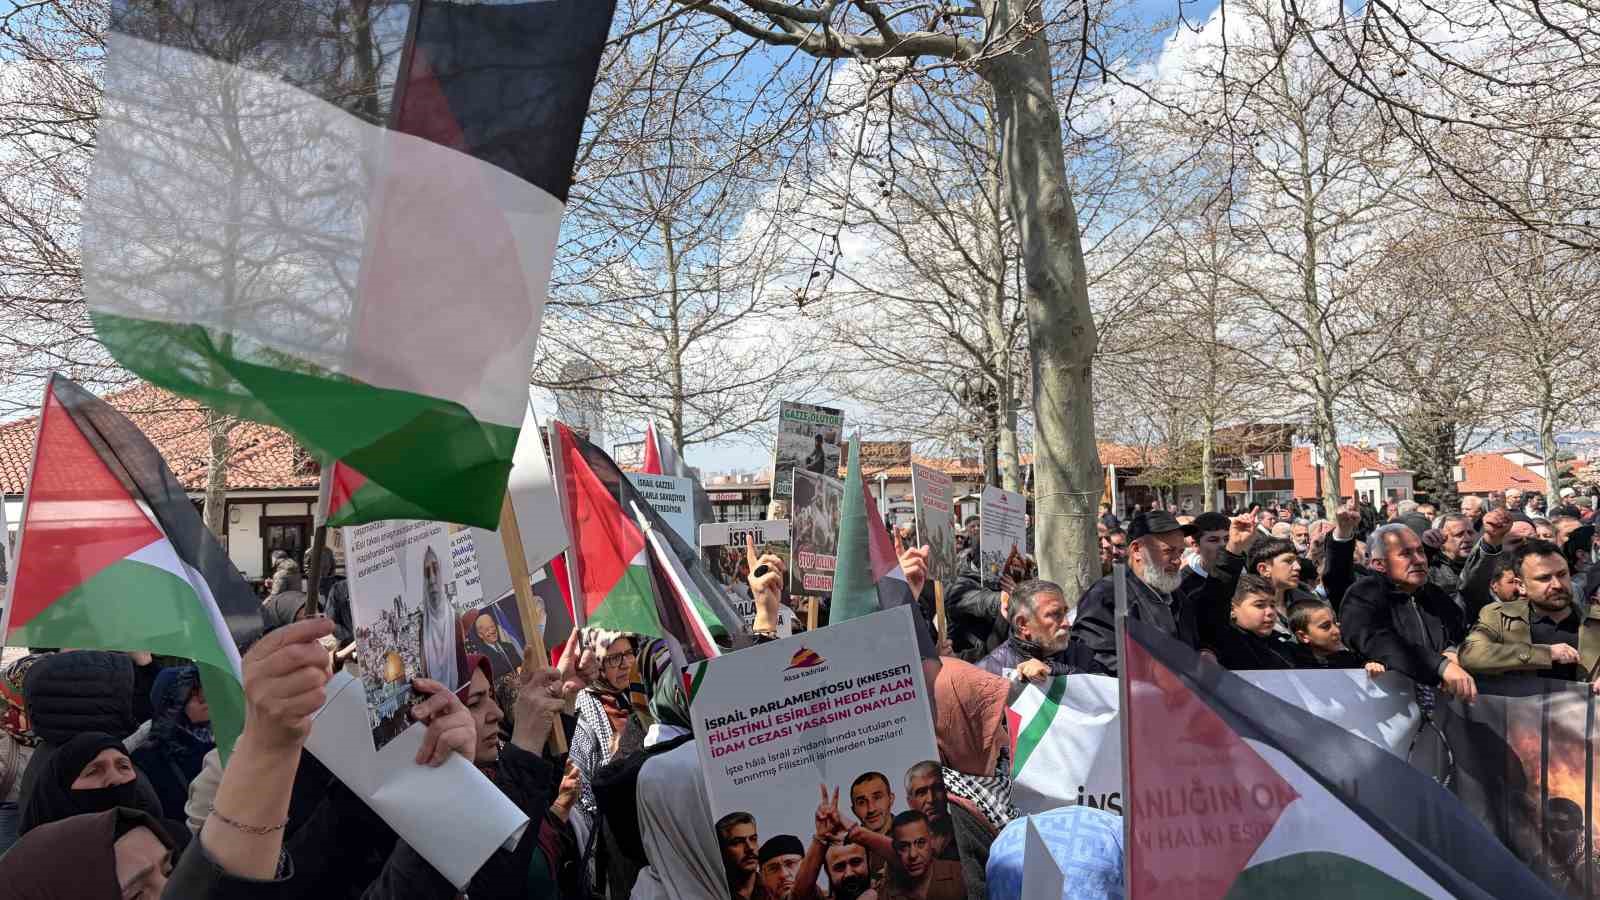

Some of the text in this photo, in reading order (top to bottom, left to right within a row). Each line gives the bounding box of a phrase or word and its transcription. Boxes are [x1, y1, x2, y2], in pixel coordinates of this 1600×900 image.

[729, 526, 765, 546] İSRAİL
[799, 551, 837, 570] STOP KILLIN
[705, 663, 912, 731] İSRAİL PARLAMENTOSU (KNESSET)
[784, 671, 801, 682] Aksa
[708, 676, 913, 745] FİLİSTİNLİ ESİRLERİ HEDEF ALAN
[711, 690, 917, 758] İDAM CEZASI YASASINI ONAYLADI
[725, 763, 744, 777] İşte
[745, 755, 767, 769] hâlâ
[792, 729, 857, 755] zindanlarında
[858, 718, 894, 736] tutulan
[894, 714, 907, 725] en
[733, 727, 904, 787] tanınmış Filistinli isimlerden bazıları!
